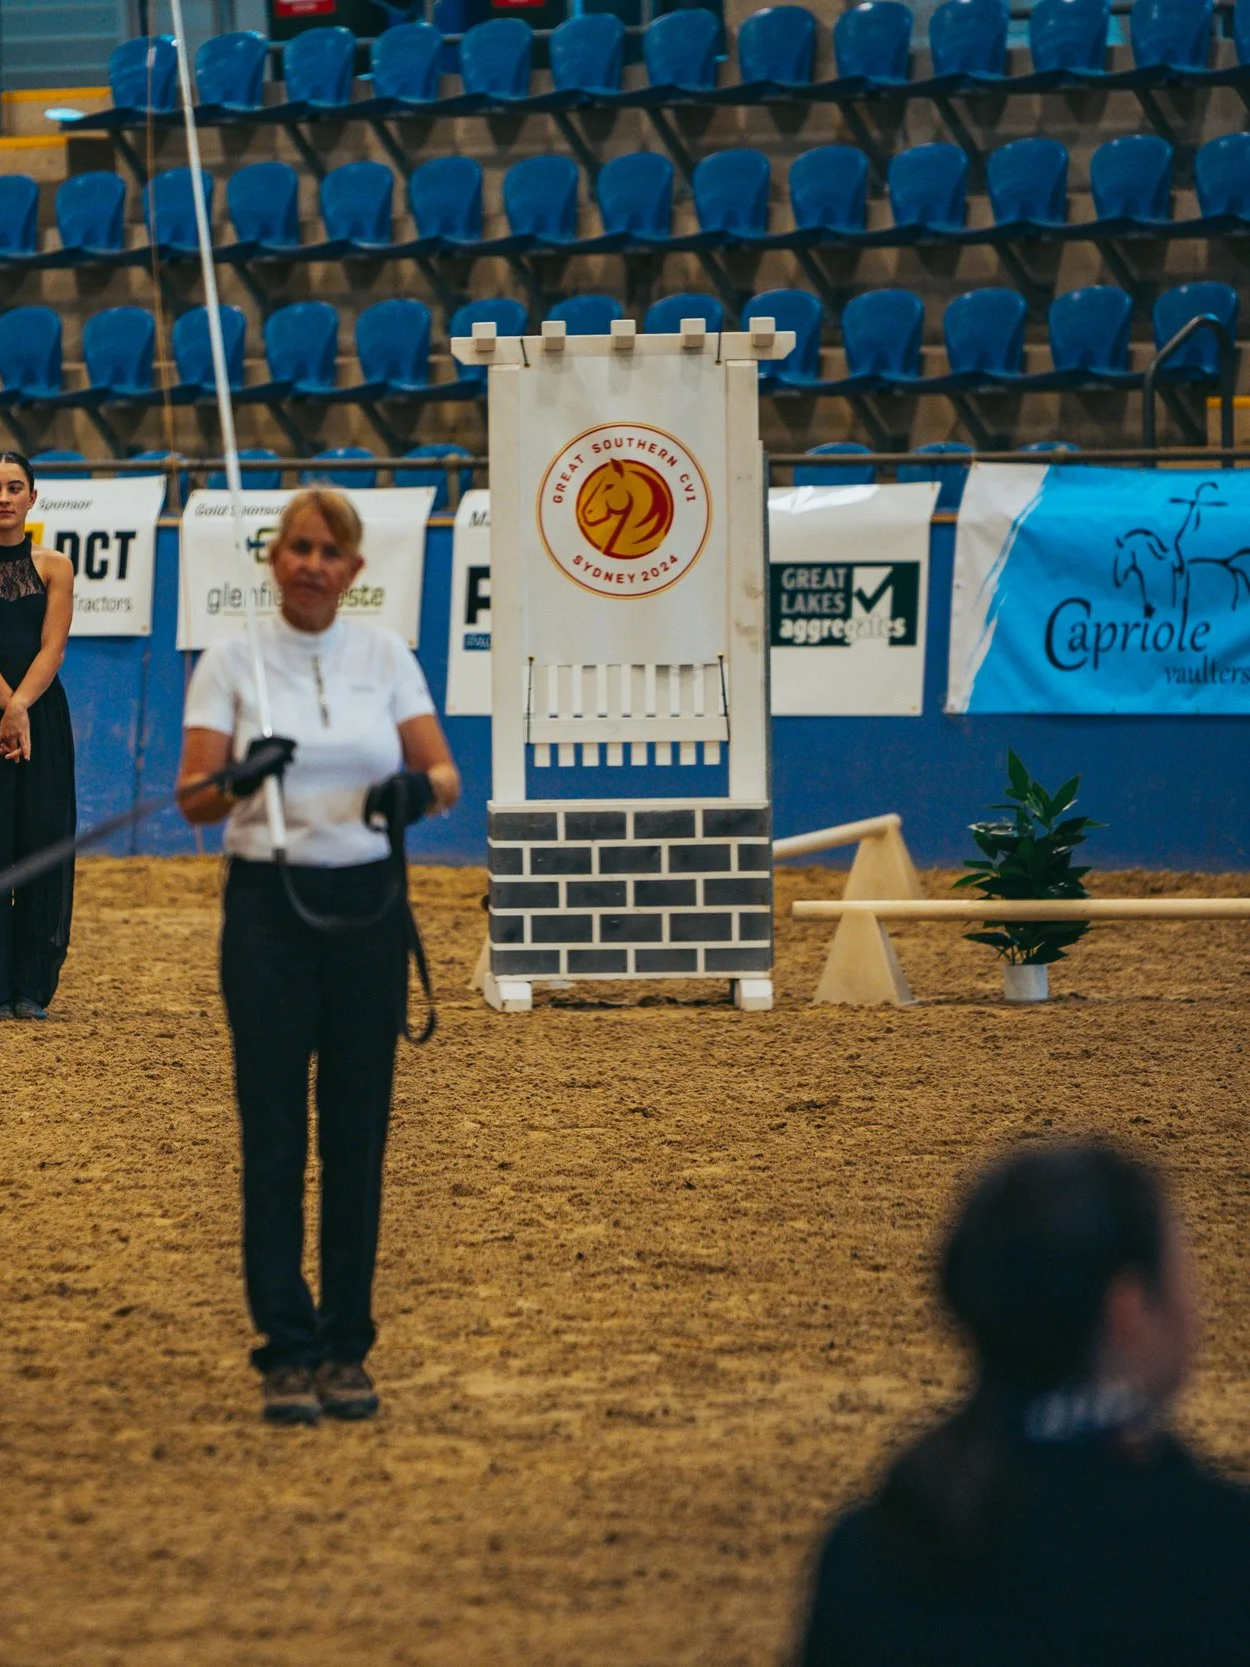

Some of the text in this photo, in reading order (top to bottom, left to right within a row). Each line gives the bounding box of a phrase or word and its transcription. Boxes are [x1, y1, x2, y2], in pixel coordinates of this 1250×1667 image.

[552, 437, 696, 503] GREAT SOUTHERN CVI
[37, 498, 92, 512] Sponsor
[572, 554, 678, 584] SYDNEY 2024
[781, 567, 847, 590] GREAT
[781, 592, 846, 614] LAKES
[779, 617, 906, 644] aggregates
[1044, 597, 1211, 672] Capriole
[1164, 653, 1250, 685] vaulters
